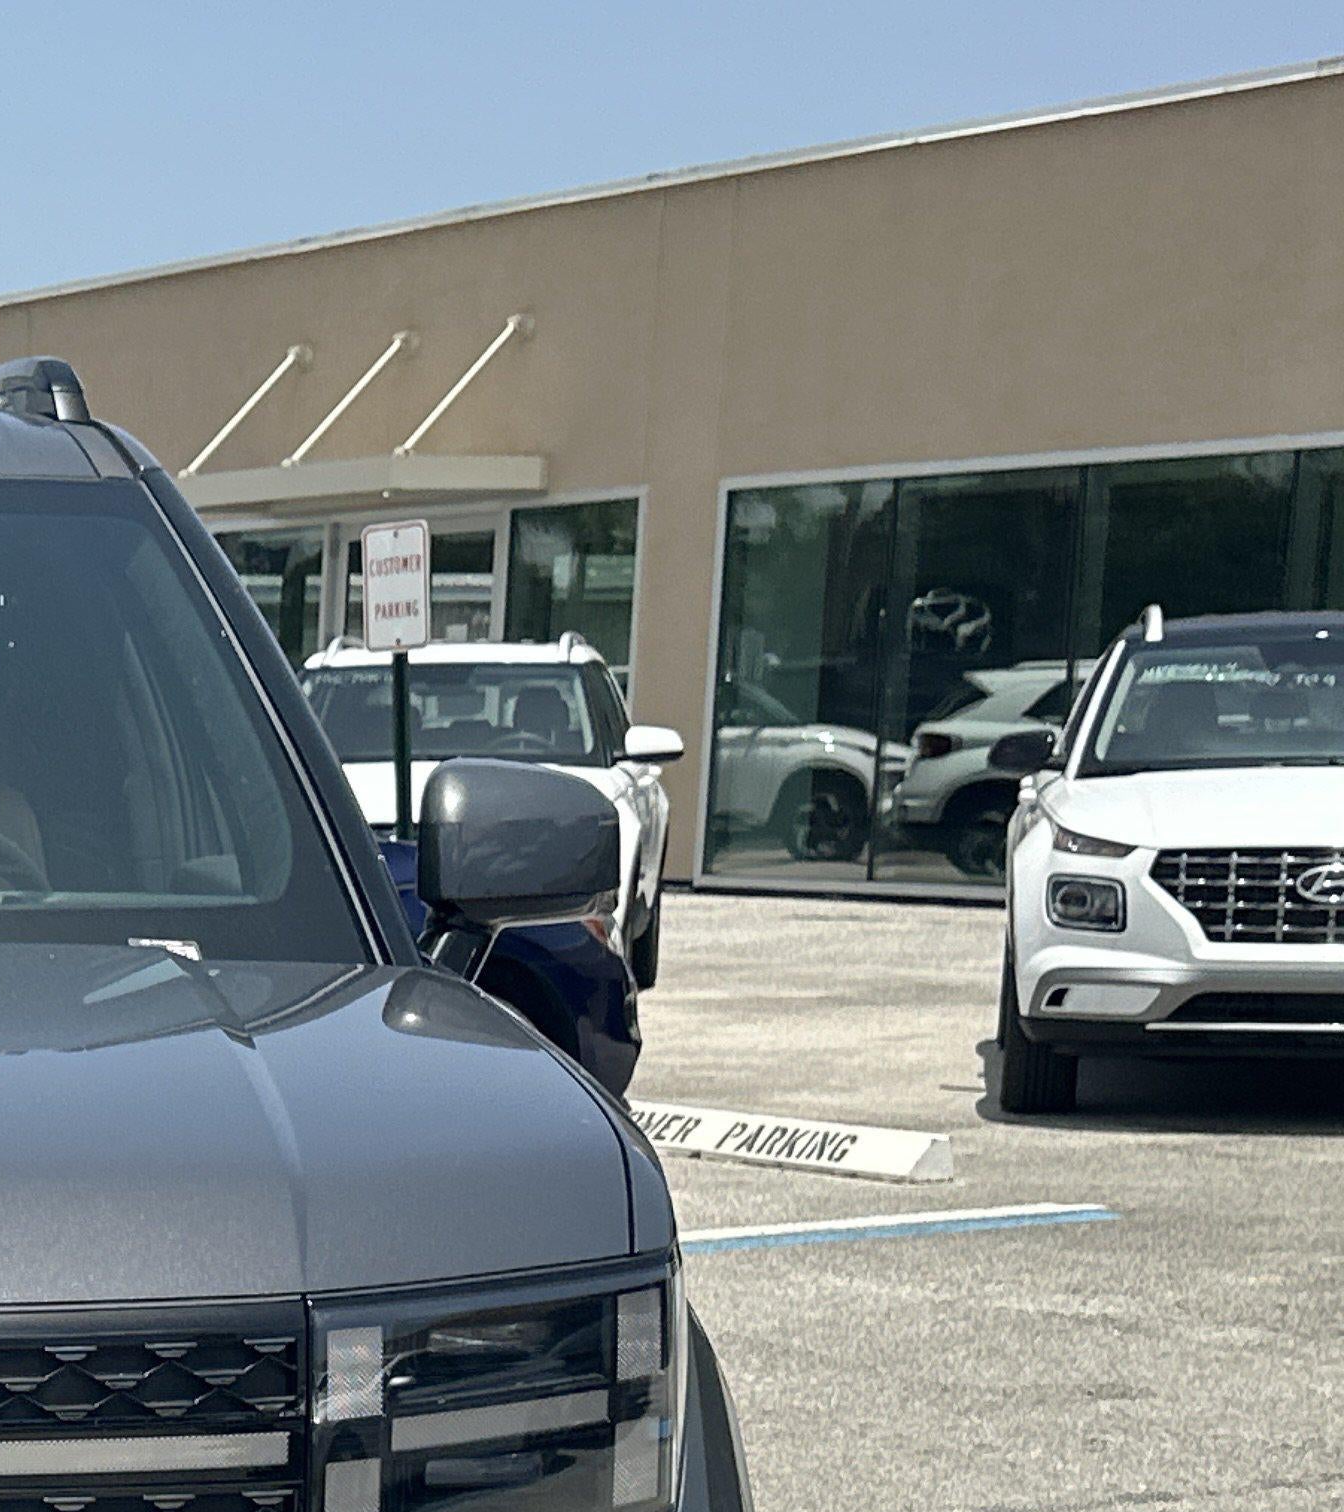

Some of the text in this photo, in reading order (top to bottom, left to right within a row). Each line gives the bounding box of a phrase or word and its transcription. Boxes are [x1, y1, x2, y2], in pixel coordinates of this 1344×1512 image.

[369, 554, 422, 577] CUSTOMER
[374, 600, 419, 621] PARKING
[715, 1121, 858, 1163] PARKING
